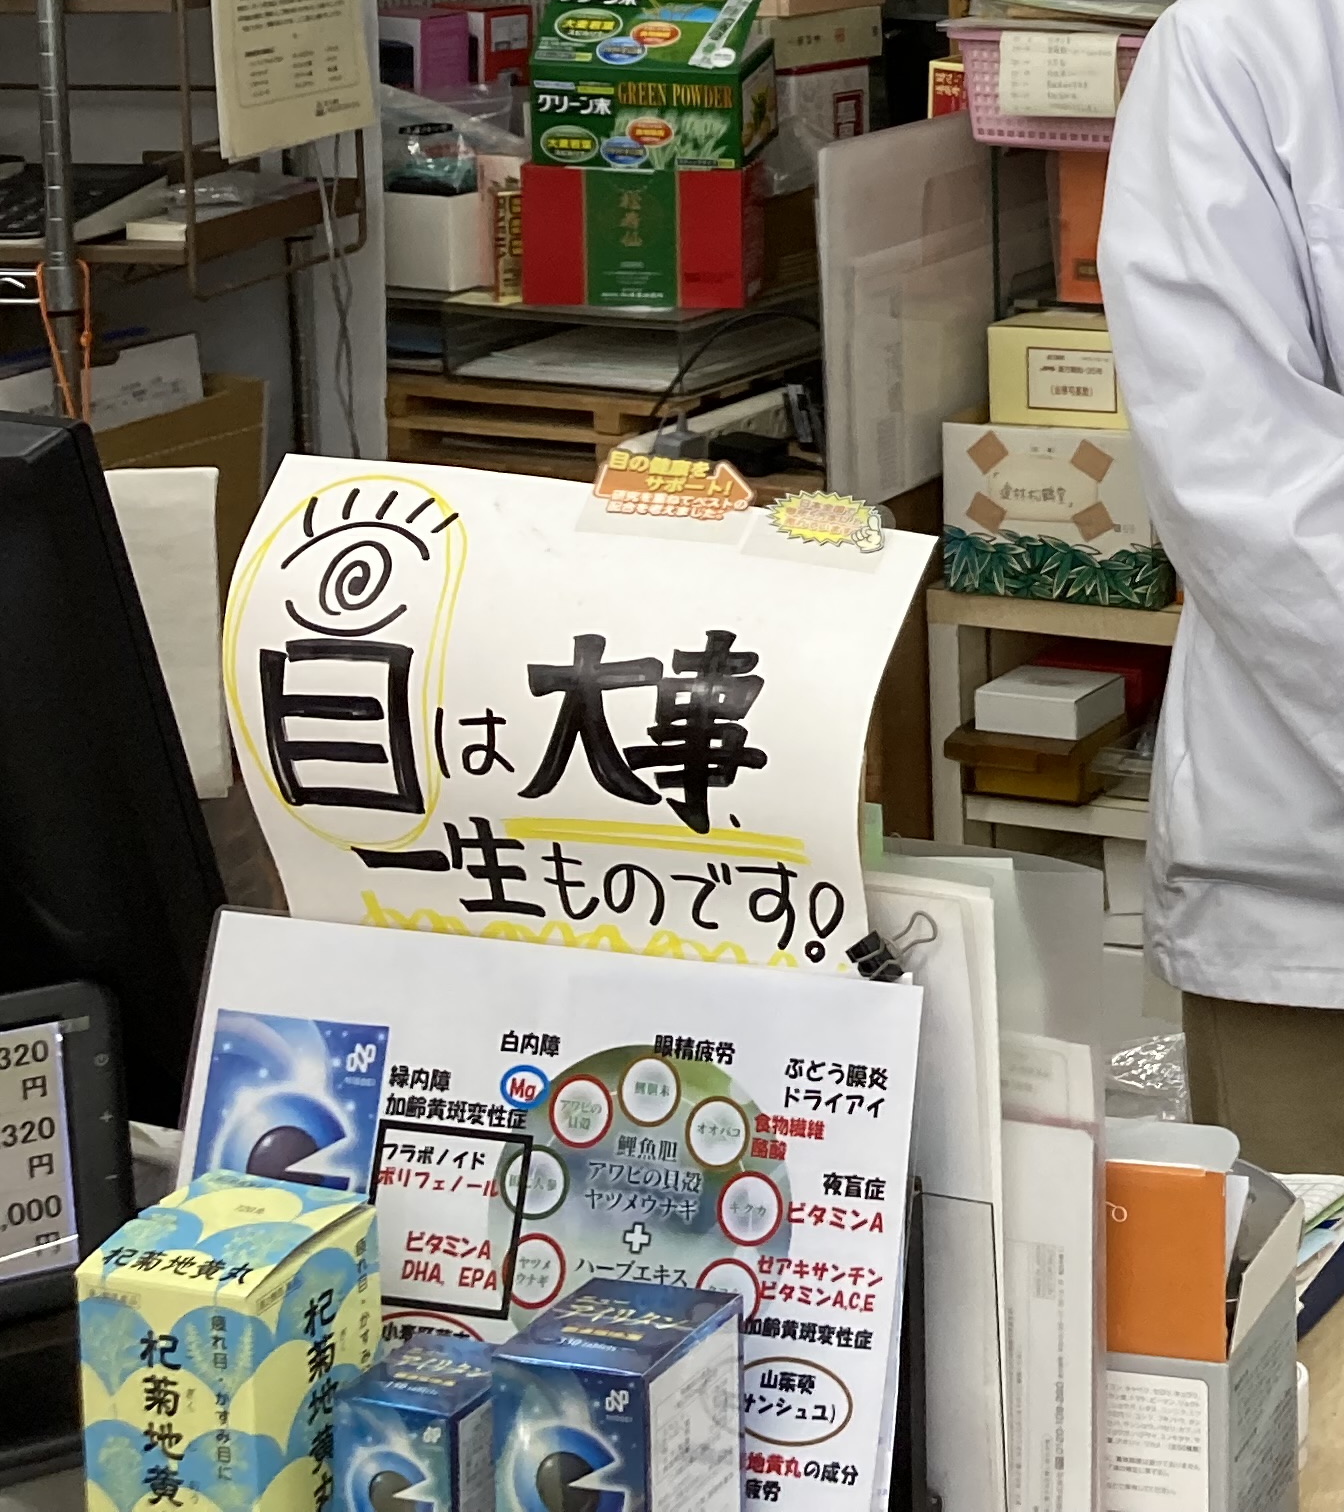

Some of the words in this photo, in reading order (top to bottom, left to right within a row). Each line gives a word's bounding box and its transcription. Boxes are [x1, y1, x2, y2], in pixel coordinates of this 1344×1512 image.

[537, 93, 612, 116] グリーン末
[617, 82, 667, 105] GREEN
[672, 84, 734, 109] POWDER
[608, 450, 711, 478] 目の健康を
[500, 1029, 561, 1057] 白内障
[654, 1033, 735, 1065] 眼精疲労
[22, 1075, 49, 1101] 円
[390, 1065, 451, 1093] 緑内障
[784, 1057, 889, 1090] ぶどう膜炎
[509, 1076, 537, 1103] Mg
[783, 1086, 886, 1118] ドライアイ
[385, 1093, 528, 1130] 加齢黄斑変性症
[754, 1113, 825, 1141] 食物繊維
[28, 1152, 55, 1179] 円
[381, 1141, 486, 1170] フラボノイド
[377, 1165, 498, 1198] ポリフェノール
[588, 1160, 702, 1194] アワビの貝殻
[823, 1172, 887, 1202] 夜盲症
[585, 1187, 698, 1222] ヤツメウナギ
[786, 1198, 885, 1235] ビタミンA
[404, 1230, 492, 1260] ビタミンA
[103, 1244, 254, 1286] 杞菊地黄丸
[458, 1265, 498, 1290] EPA
[574, 1256, 688, 1288] ハーブエキス
[757, 1254, 884, 1287] ゼアキサンチン
[743, 1317, 874, 1351] 加齢黄斑変性症
[209, 1315, 233, 1482] 疲れ目・かすみ目に
